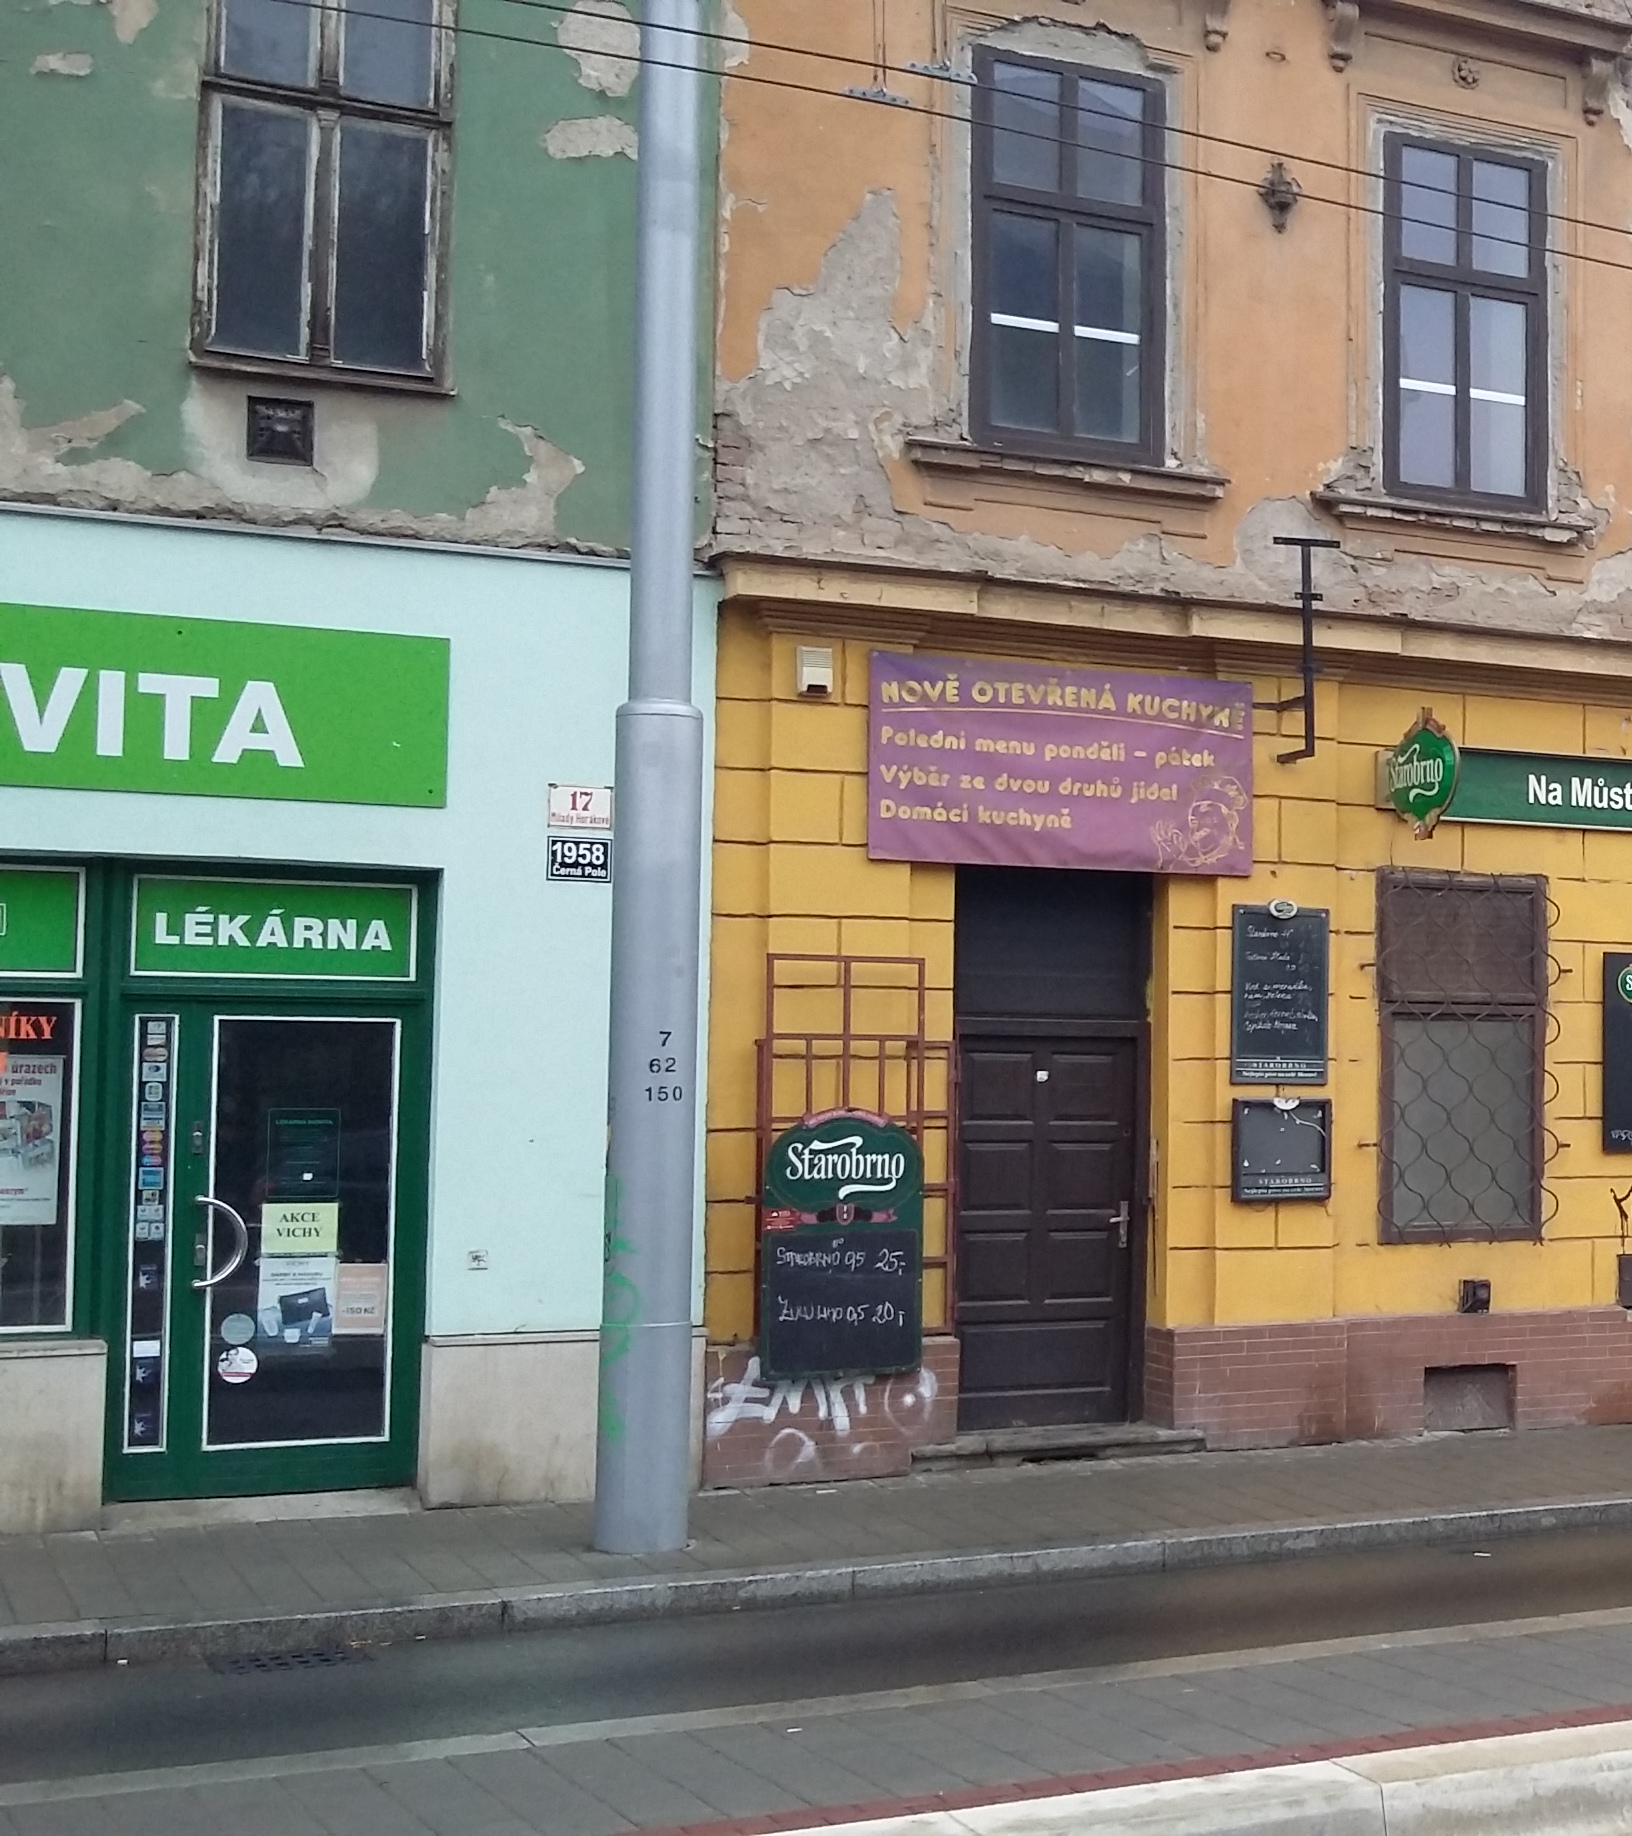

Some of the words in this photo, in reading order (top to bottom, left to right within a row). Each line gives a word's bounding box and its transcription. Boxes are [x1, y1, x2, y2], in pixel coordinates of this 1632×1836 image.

[0, 662, 305, 768] VITA
[880, 674, 960, 703] NOVĚ
[971, 677, 1117, 712] OTEVŘENÁ
[1127, 692, 1246, 731] KUCHYNĚ
[880, 726, 966, 750] Polední
[975, 737, 1036, 756] menu
[1044, 741, 1126, 762] pondělí
[1155, 746, 1215, 769] pátek
[879, 764, 950, 790] Výběr
[959, 774, 986, 790] ze
[994, 773, 1050, 794] dvou
[1058, 776, 1122, 799] druhů
[1130, 781, 1178, 804] jídel
[1387, 743, 1444, 804] Starobrno
[570, 791, 593, 811] 17
[1528, 774, 1562, 806] Na
[879, 798, 969, 823] Domácí
[978, 804, 1072, 832] kuchyně
[552, 841, 605, 865] 1958
[552, 862, 583, 875] Černá
[153, 905, 393, 952] LÉKÁRNA
[659, 1031, 672, 1047] 7
[11, 1061, 57, 1074] úrazech
[649, 1057, 676, 1073] 62
[645, 1086, 682, 1102] 150
[786, 1135, 906, 1200] Starobrno
[280, 1212, 320, 1223] AKCE
[276, 1227, 322, 1238] VICHY
